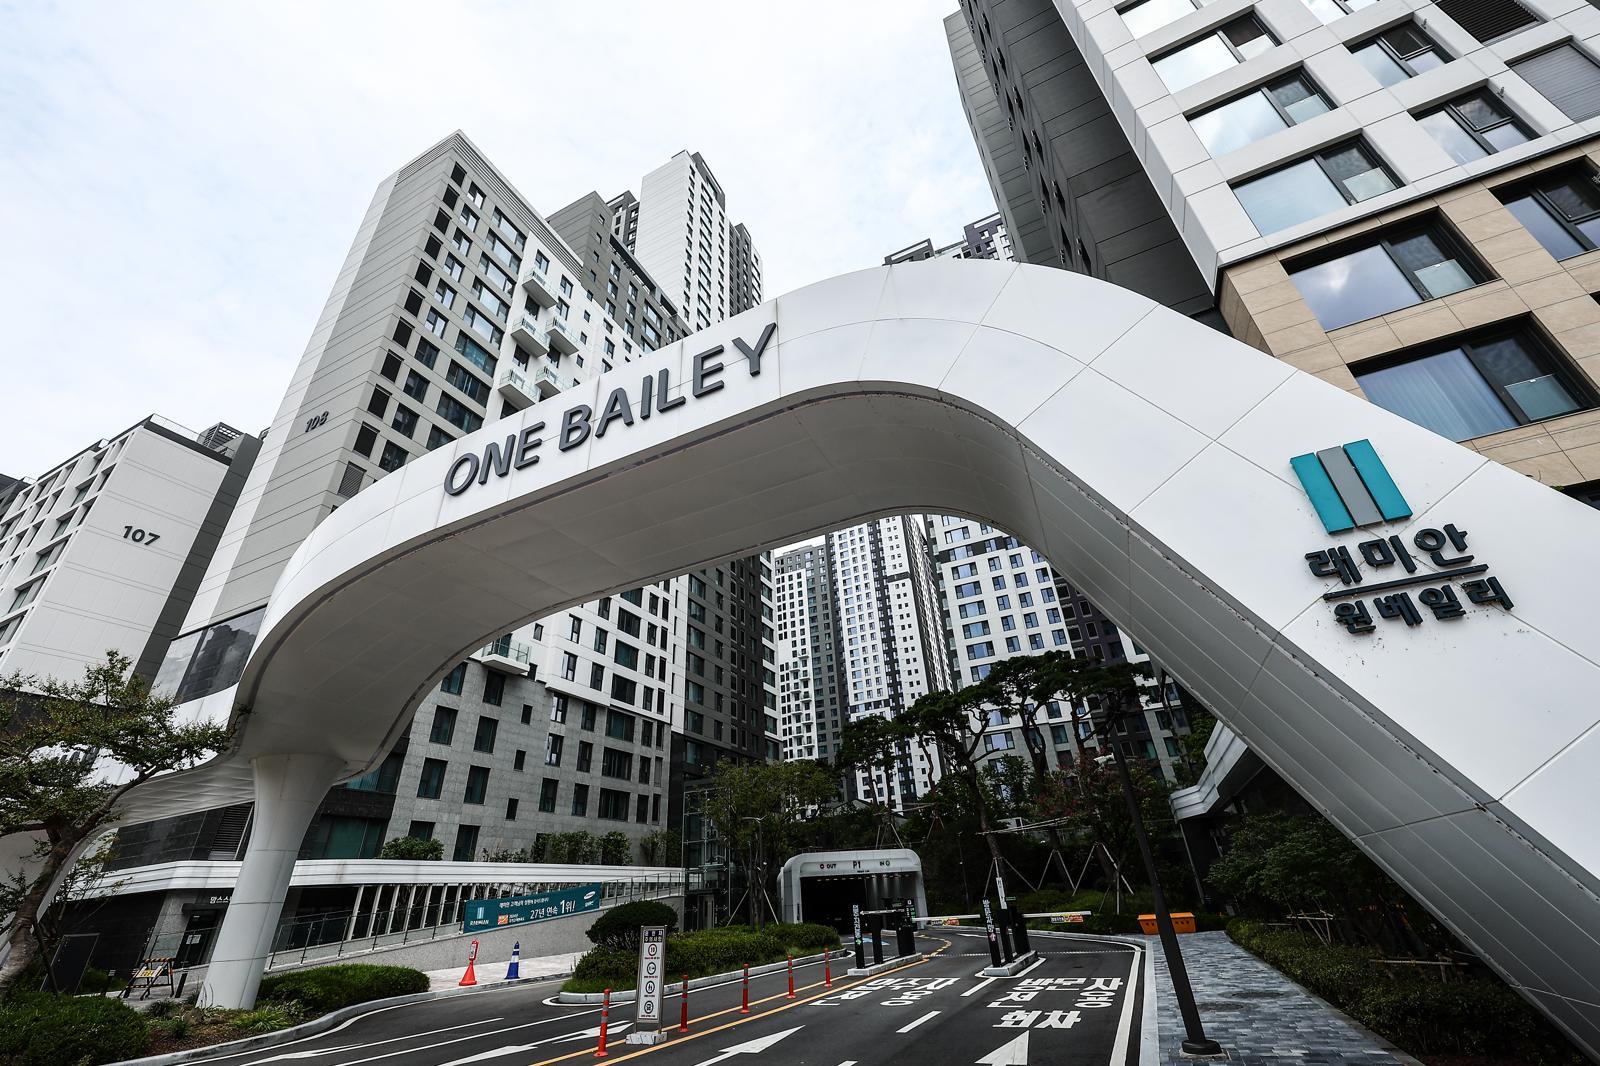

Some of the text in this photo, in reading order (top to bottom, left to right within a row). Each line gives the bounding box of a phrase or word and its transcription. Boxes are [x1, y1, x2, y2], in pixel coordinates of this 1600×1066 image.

[443, 322, 777, 497] ONE BAILEY
[123, 525, 161, 546] 107
[1304, 523, 1475, 585] 래미안
[1333, 576, 1515, 635] 원베일리
[530, 908, 545, 920] 27년
[546, 906, 558, 917] 연속
[560, 899, 576, 914] 1위!
[854, 977, 961, 991] 입주자
[1012, 977, 1124, 991] 방문자
[992, 1010, 1082, 1029] 회차
